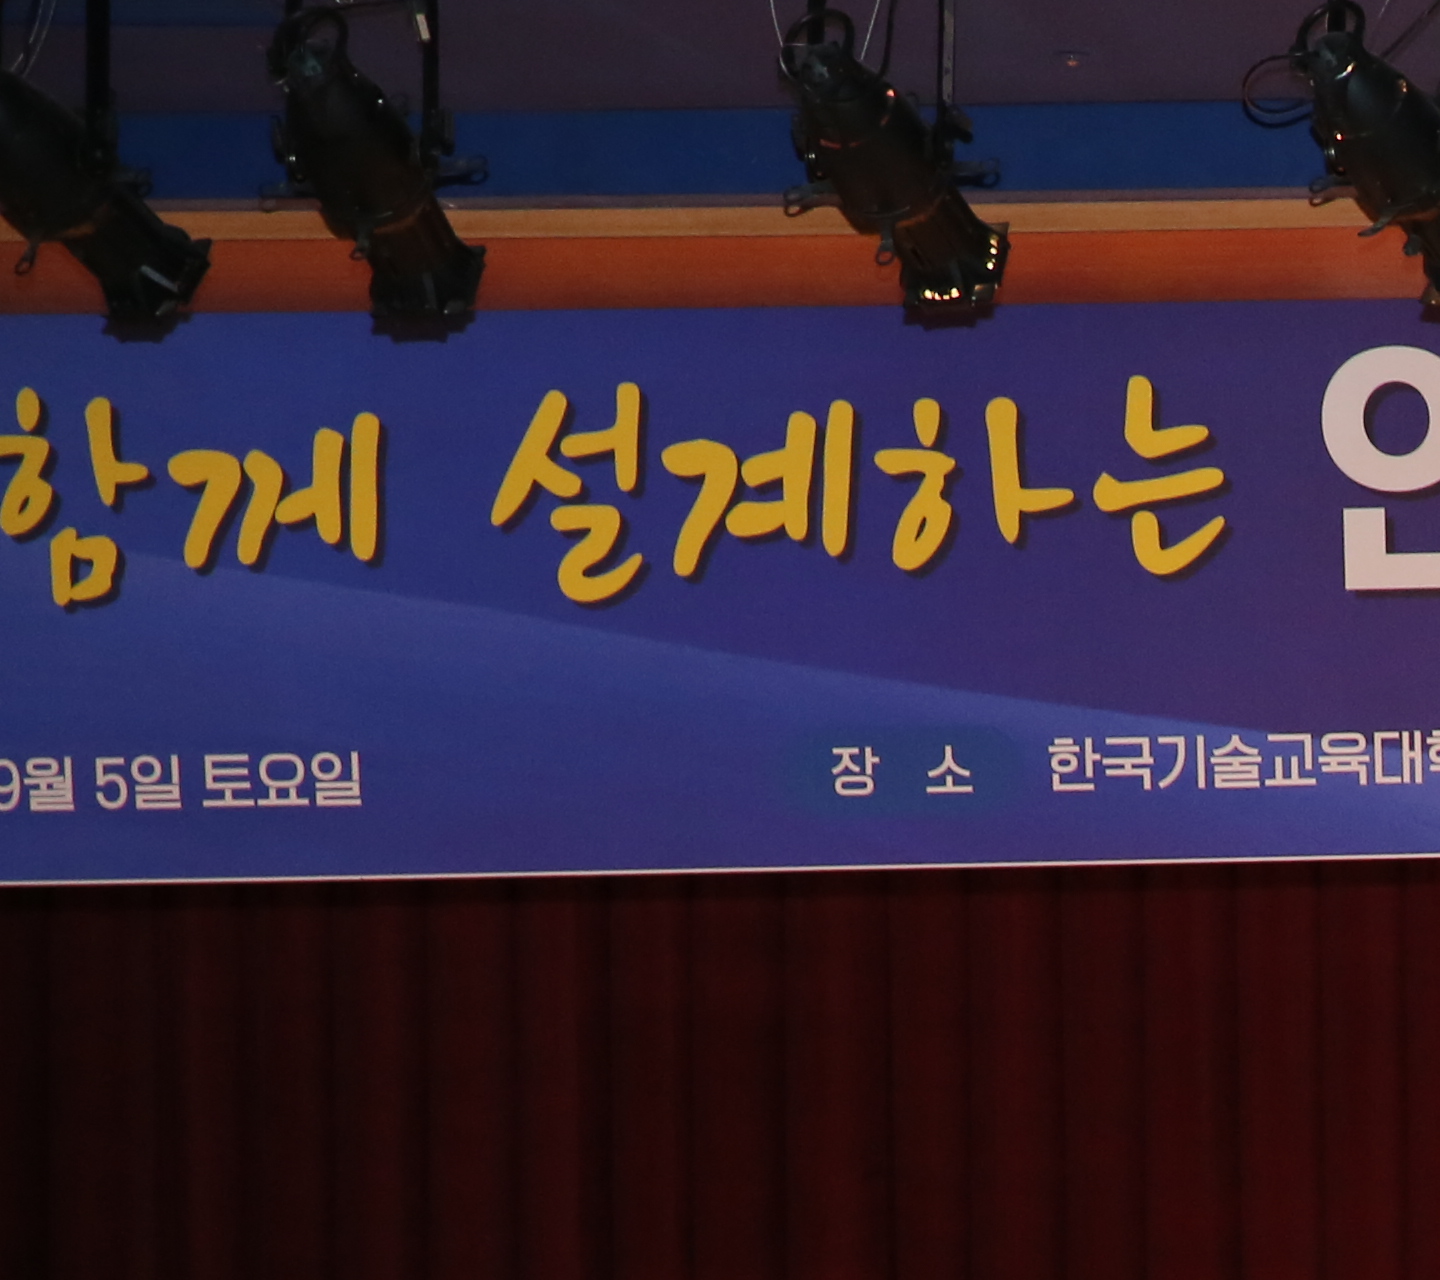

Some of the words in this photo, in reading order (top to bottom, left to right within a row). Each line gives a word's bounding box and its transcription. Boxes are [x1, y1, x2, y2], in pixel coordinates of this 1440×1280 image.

[0, 388, 380, 606] 함께
[490, 376, 1226, 603] 설계하는
[95, 754, 182, 810] 5일
[202, 751, 363, 808] 토요일
